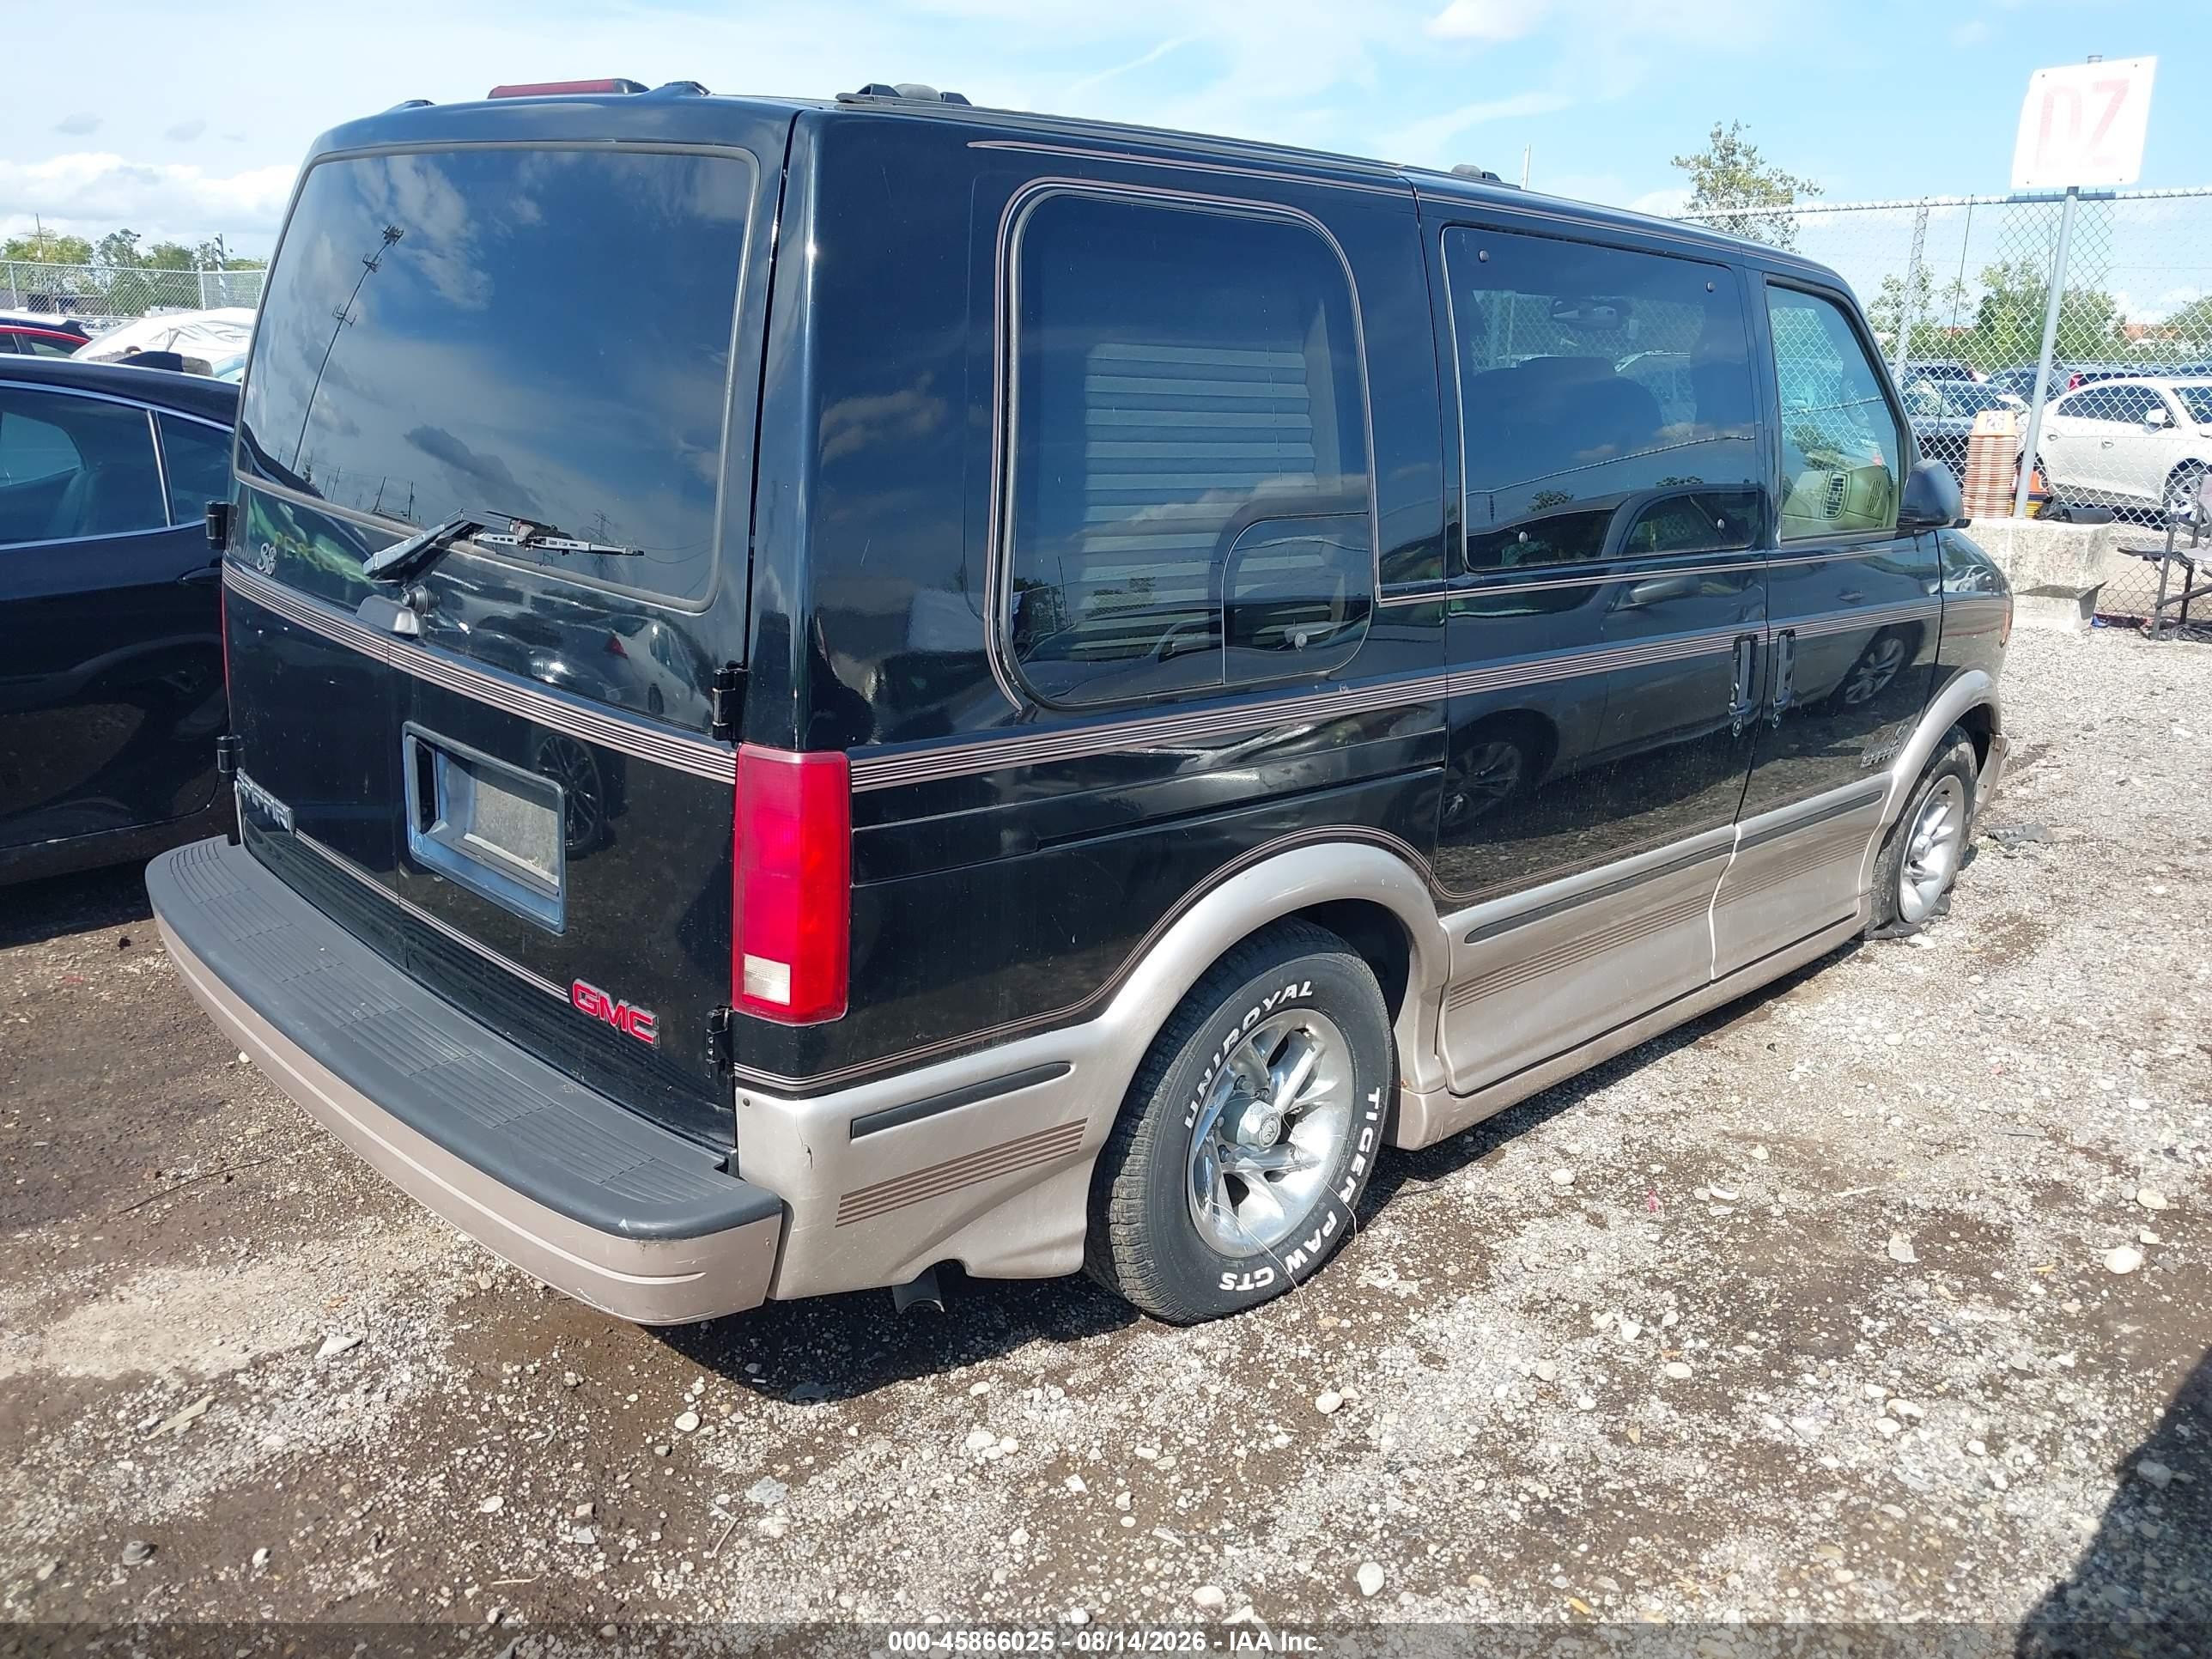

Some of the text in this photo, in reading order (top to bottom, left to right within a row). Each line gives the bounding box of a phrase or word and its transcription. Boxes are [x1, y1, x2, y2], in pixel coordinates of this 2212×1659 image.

[573, 979, 659, 1048] GMC
[1185, 981, 1313, 1129] UNIROYAL
[1340, 1087, 1381, 1203] TIGER
[1285, 1210, 1338, 1274] PAW
